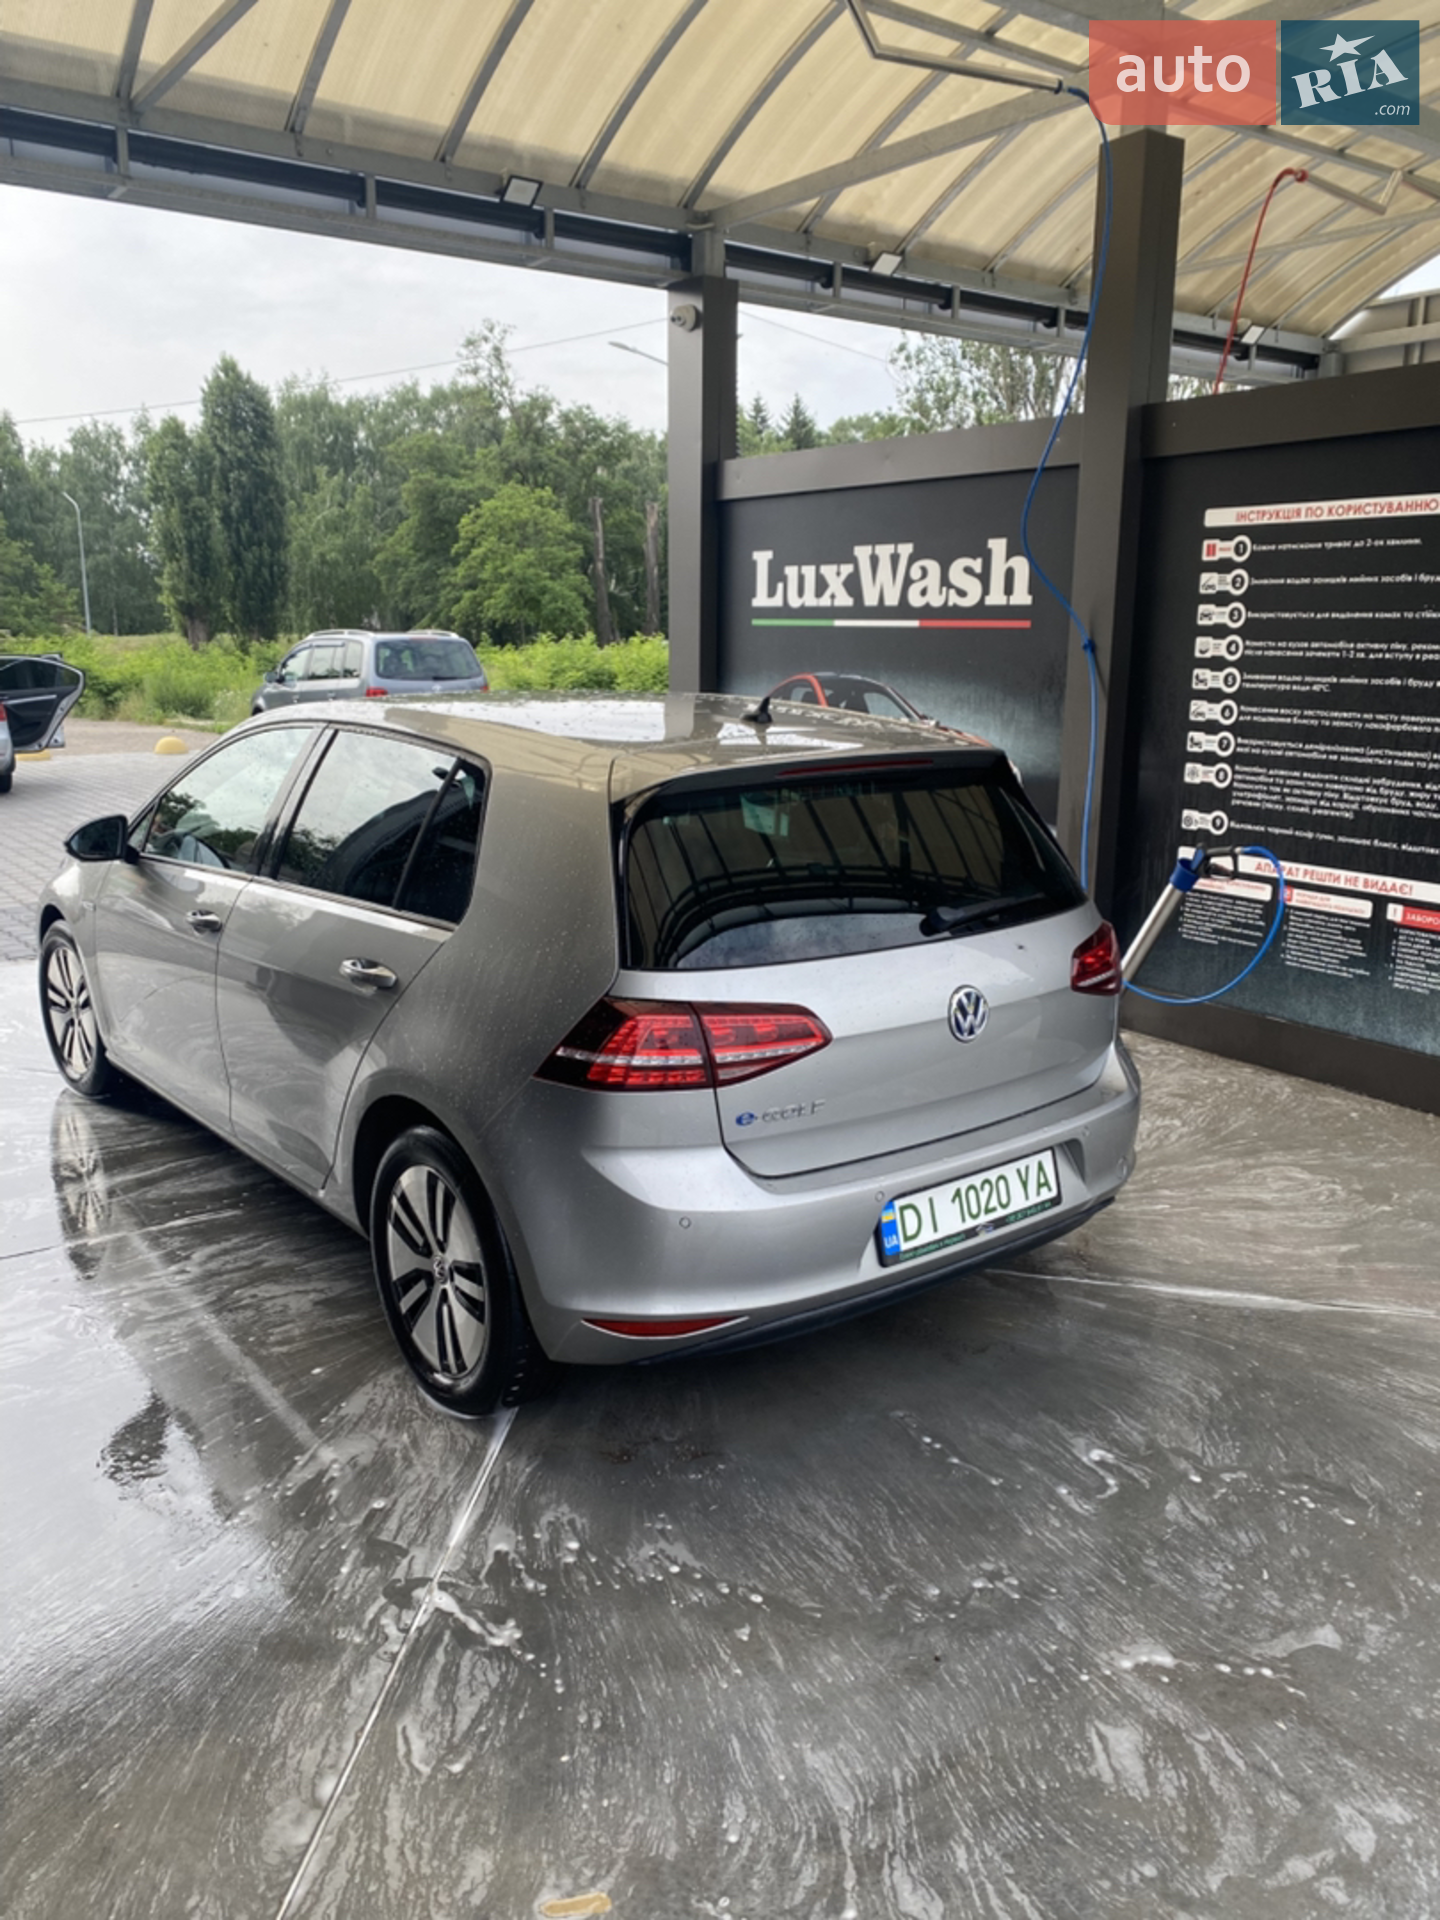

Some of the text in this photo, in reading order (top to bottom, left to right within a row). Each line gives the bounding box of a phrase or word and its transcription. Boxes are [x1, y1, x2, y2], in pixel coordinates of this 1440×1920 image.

[1235, 498, 1439, 523] ІНСТРУКЦІЯ ПО КОРИСТУВАННЮ
[751, 537, 1033, 608] LuxWash
[1254, 861, 1414, 896] АПРАТ РЕШТИ НЕ ВИДАЄ!
[884, 1235, 898, 1248] UA
[899, 1196, 938, 1243] DI
[951, 1174, 1011, 1223] 1020
[1016, 1160, 1053, 1200] YA
